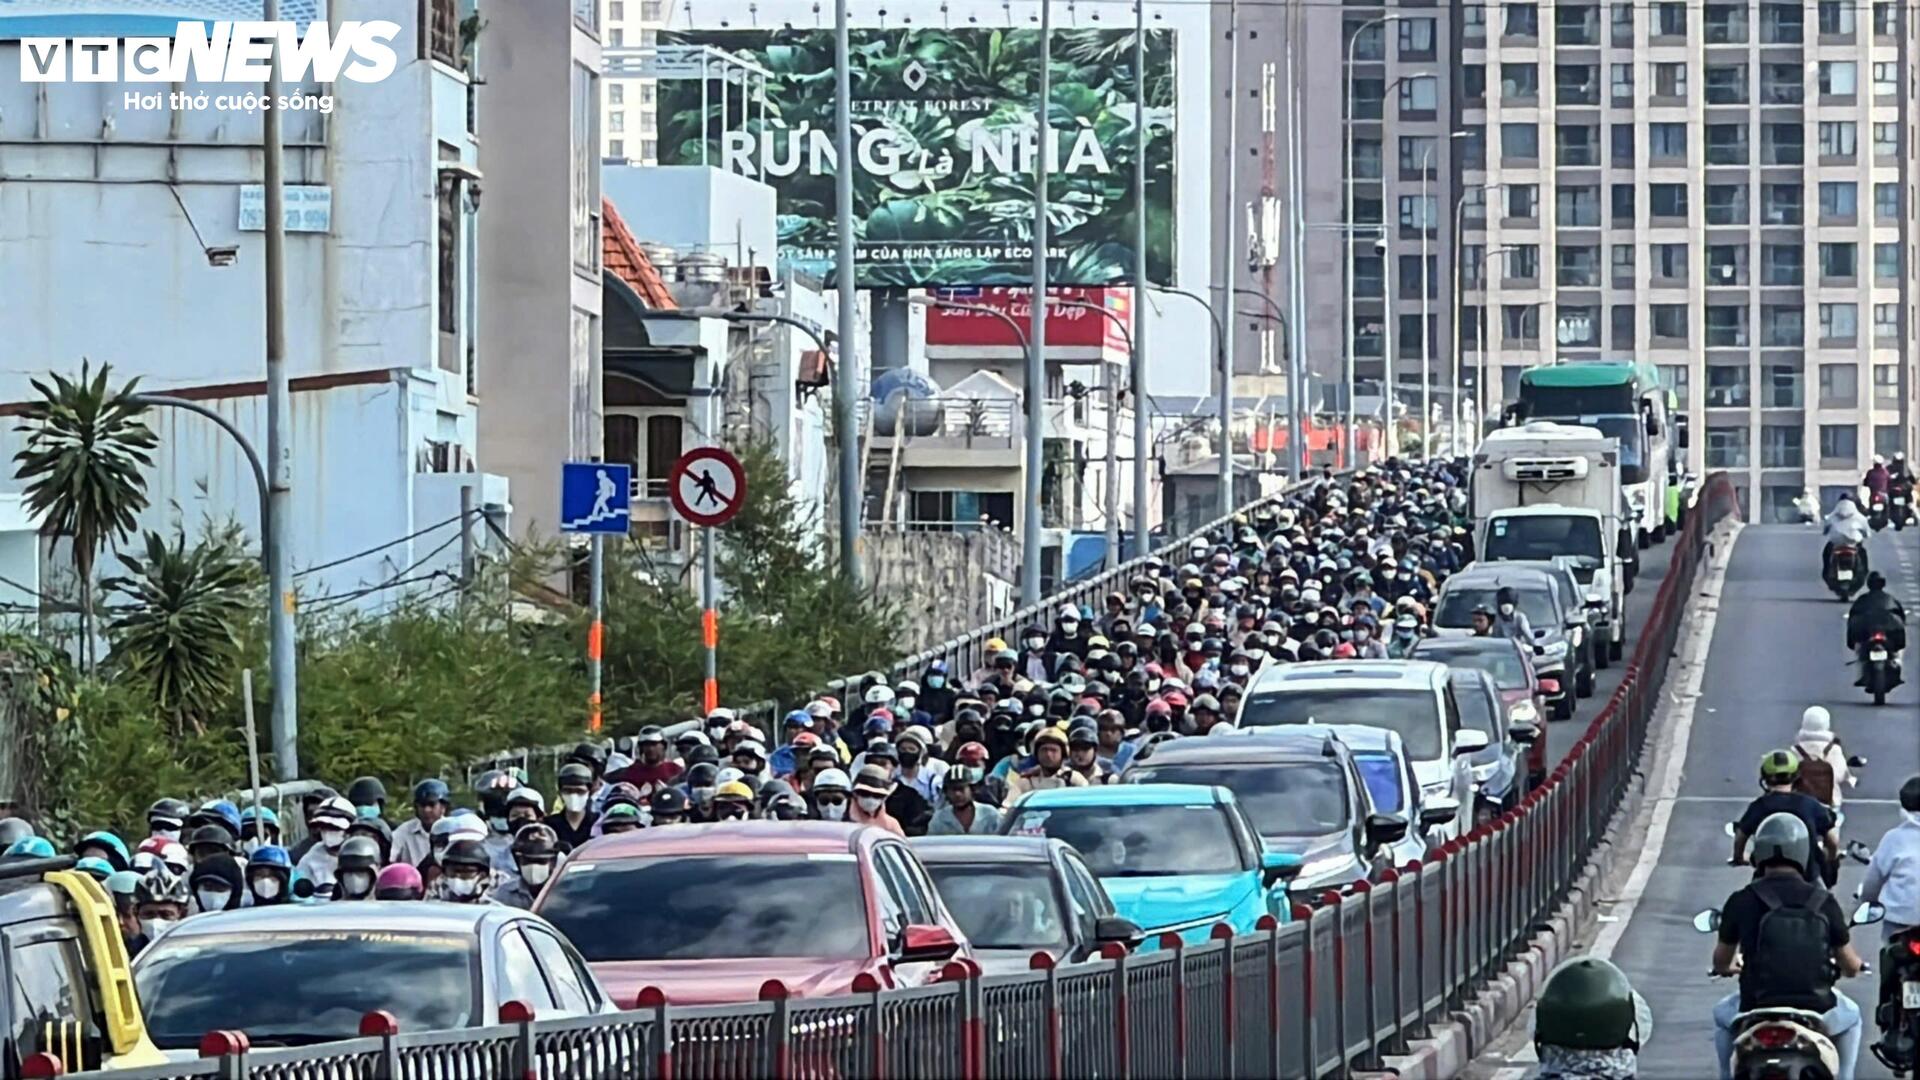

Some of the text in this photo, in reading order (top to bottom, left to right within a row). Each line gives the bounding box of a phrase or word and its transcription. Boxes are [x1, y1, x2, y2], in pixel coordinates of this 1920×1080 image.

[851, 100, 992, 112] ETREAT FOREST
[722, 116, 1111, 176] RỪNG Là NHÀ
[871, 246, 899, 260] CỦA
[903, 246, 932, 259] NHÀ
